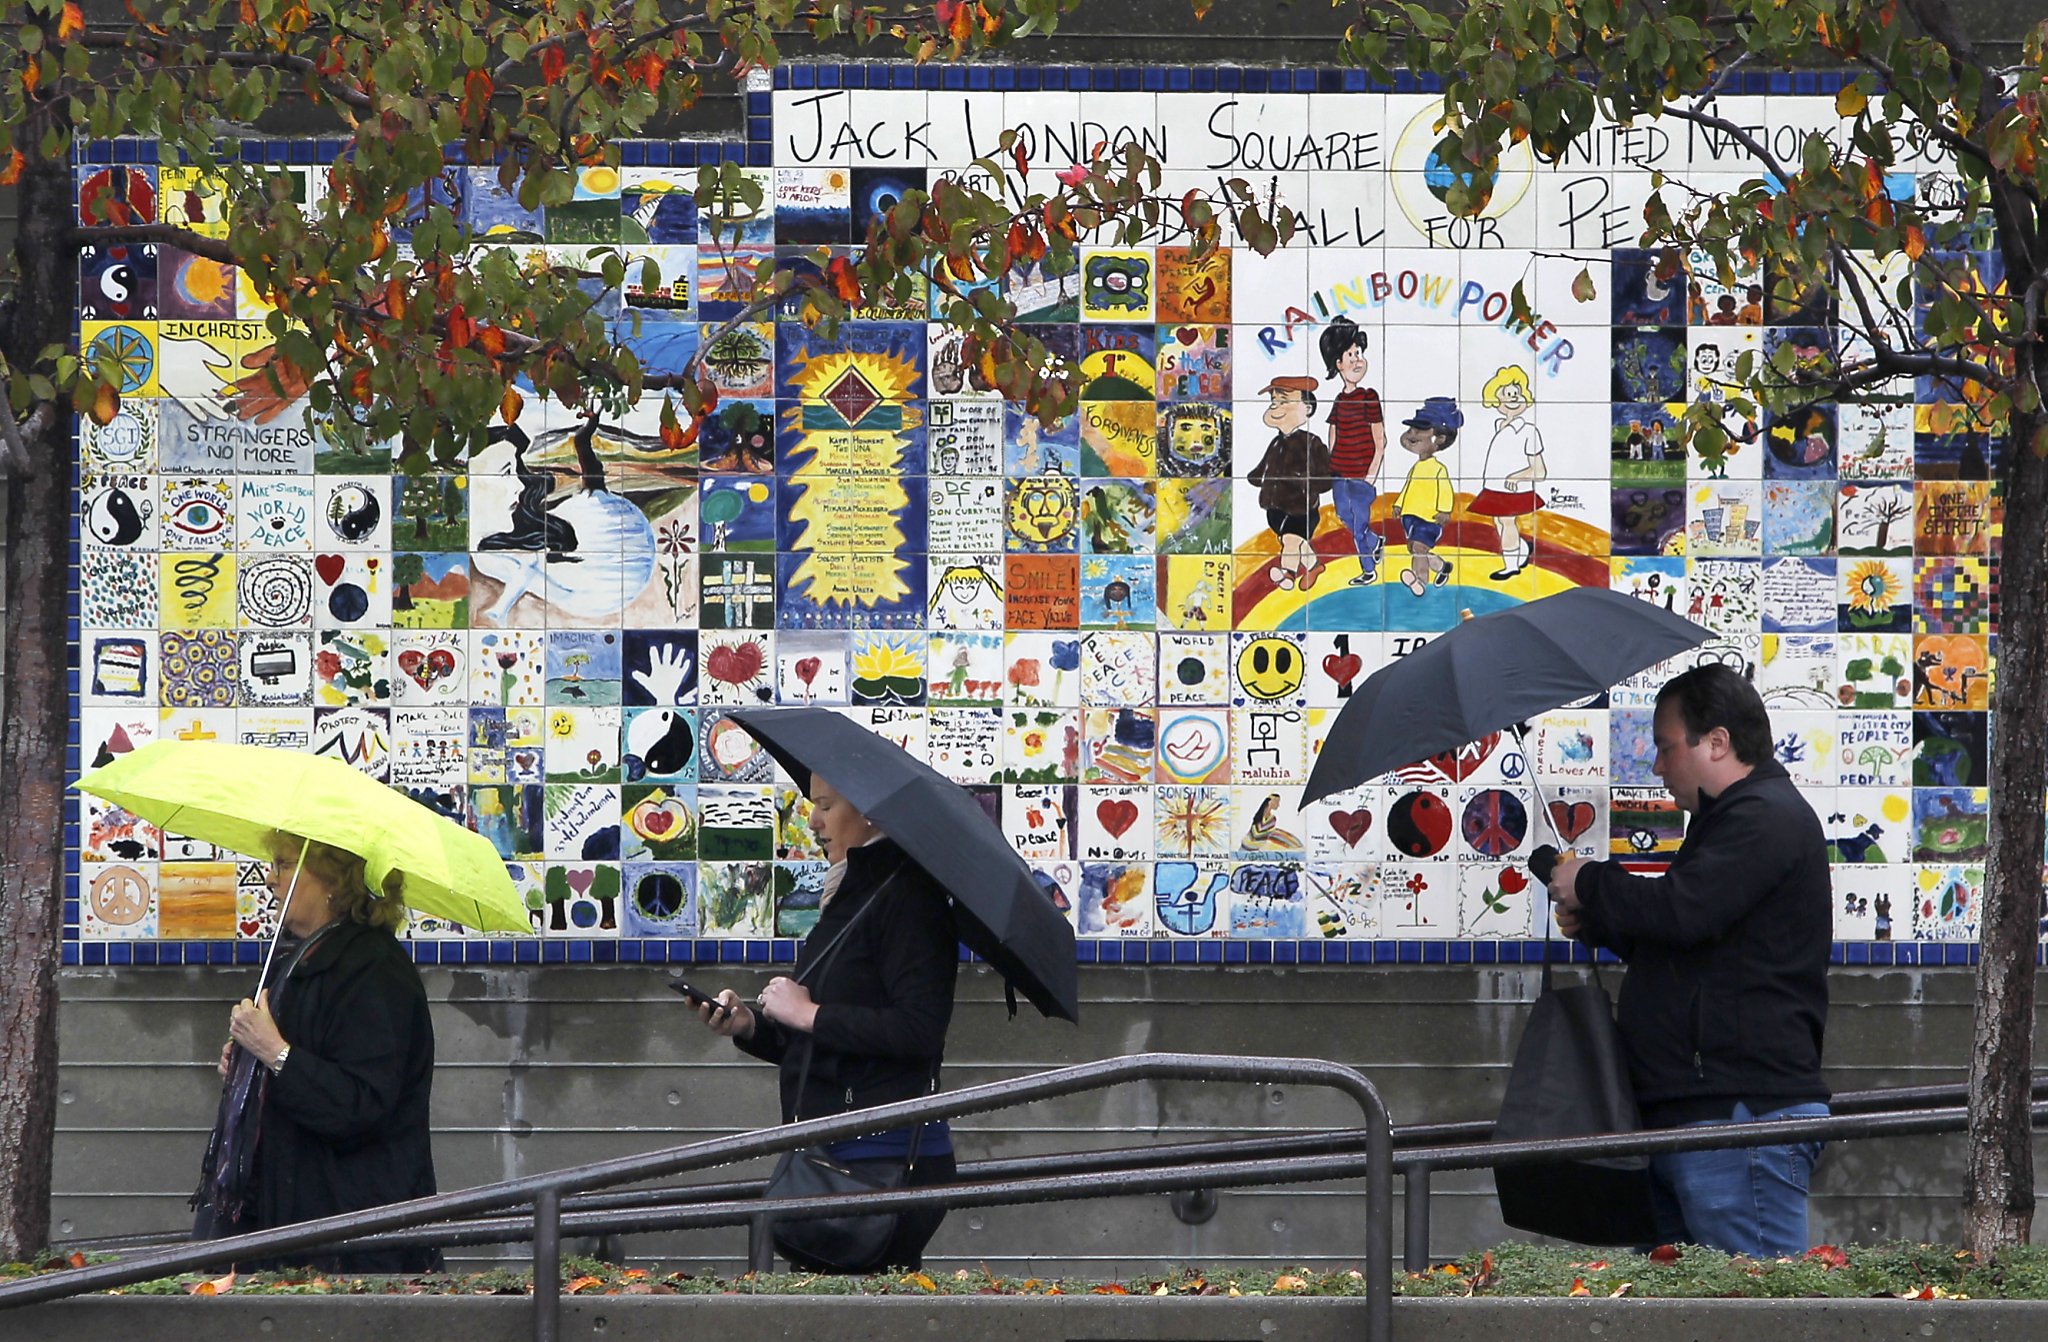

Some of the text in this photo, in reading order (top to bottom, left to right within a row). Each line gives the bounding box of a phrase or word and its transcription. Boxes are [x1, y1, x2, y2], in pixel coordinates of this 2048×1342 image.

[790, 91, 937, 163] JACK
[1207, 101, 1381, 171] SQUARE
[1423, 215, 1505, 249] FOR
[166, 322, 193, 335] IN
[1256, 269, 1576, 376] RAINBOW POER
[1860, 409, 1887, 418] PEAE
[102, 426, 139, 446] SGI
[187, 423, 313, 447] STRANGERS
[207, 447, 296, 463] NO MORE
[100, 474, 149, 491] PEACE
[170, 489, 192, 508] ONE
[246, 499, 306, 524] WORLD
[1923, 518, 1984, 535] SPIRIT
[250, 525, 306, 547] PEACE
[1008, 562, 1076, 592] SMILE!
[1008, 611, 1037, 624] FACE
[549, 632, 597, 644] IMAGINE
[1172, 636, 1215, 646] WORLD
[1170, 692, 1207, 703] PEACE
[319, 717, 361, 735] PROTECT
[396, 713, 429, 724] Make
[1841, 730, 1890, 746] PEOPLE
[1241, 766, 1291, 779] maluhia
[1549, 763, 1606, 777] Loves ME
[1840, 773, 1897, 785] PEOPLE
[1157, 786, 1217, 801] SONSHINE
[1647, 789, 1667, 799] THE
